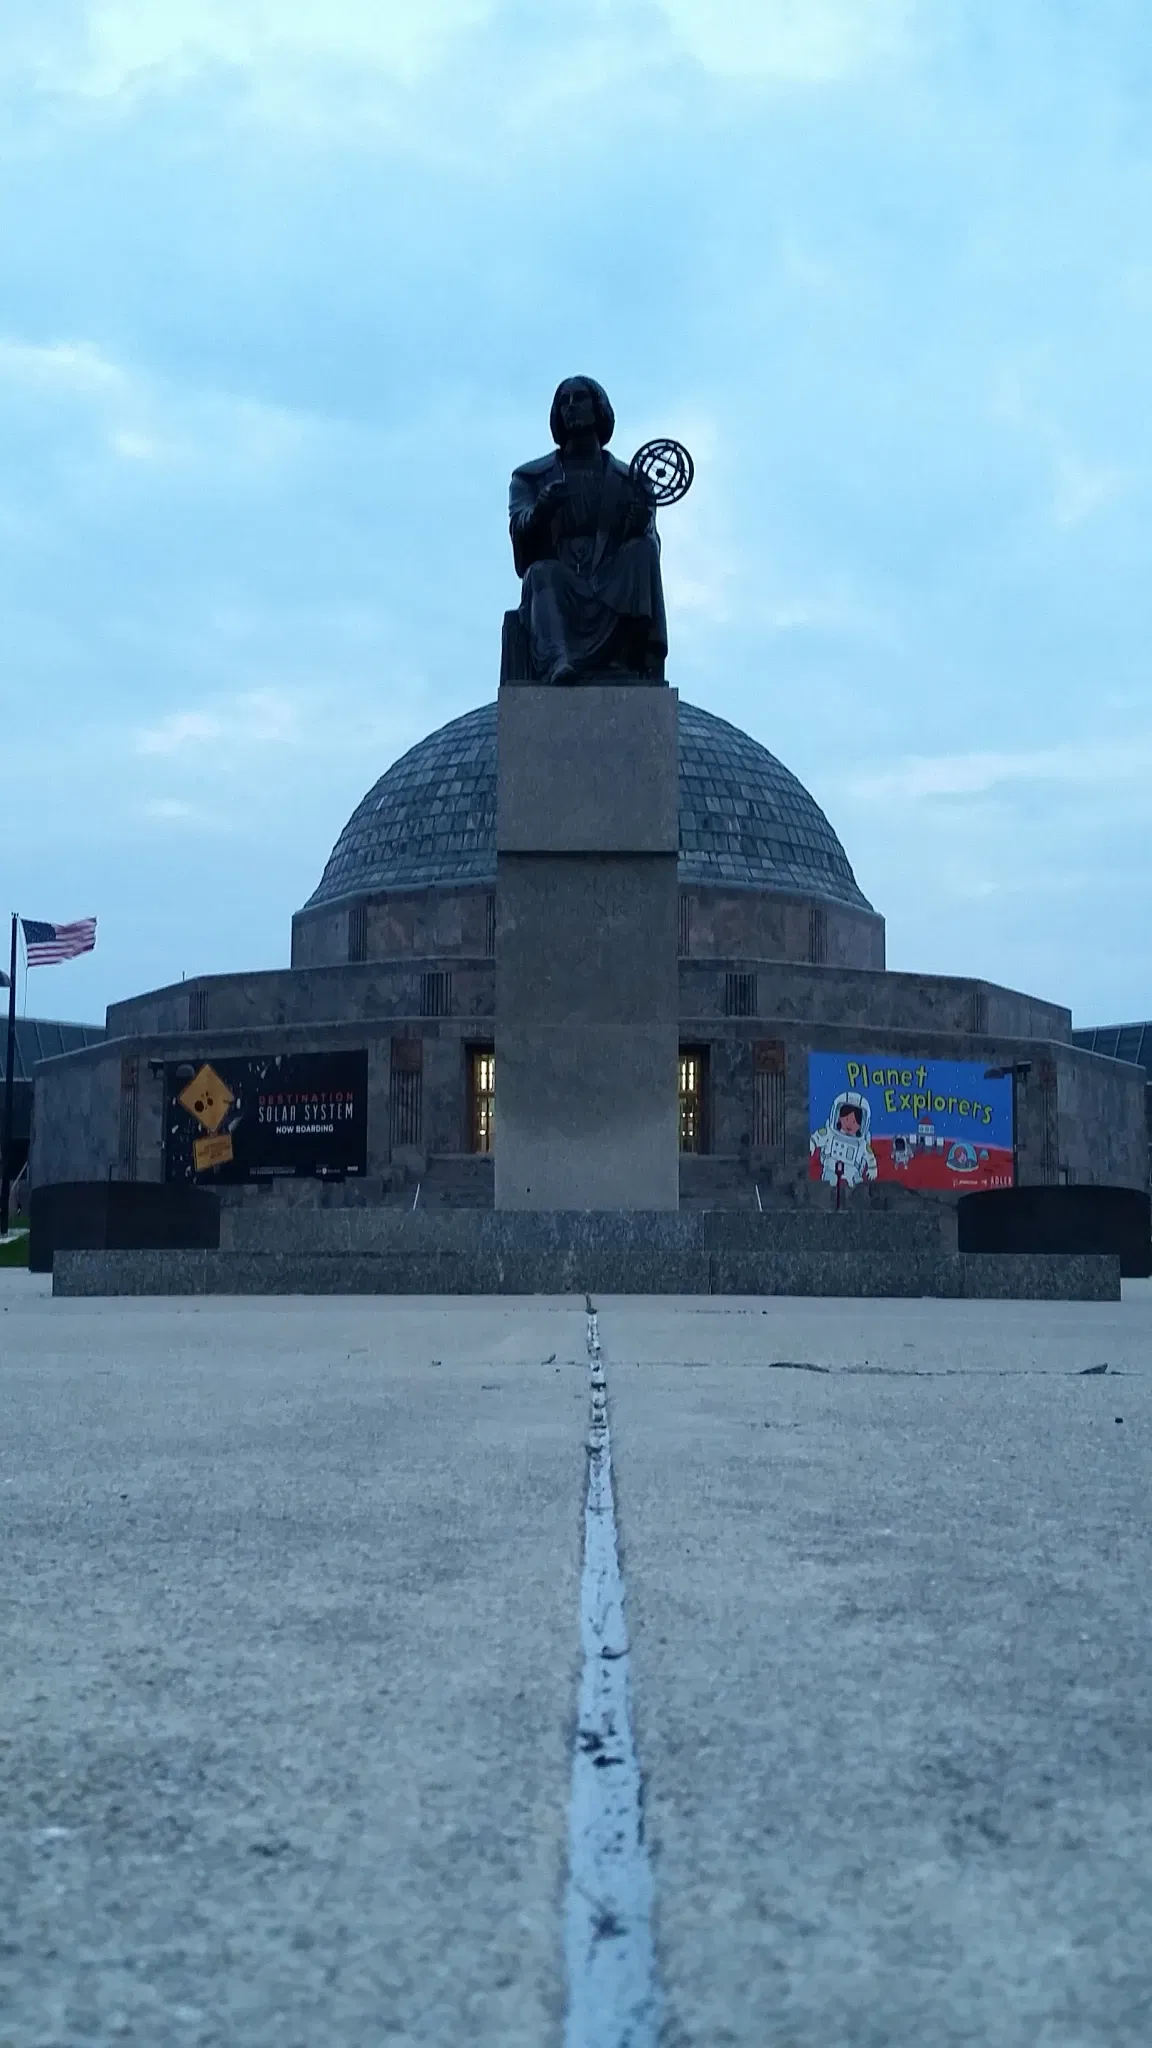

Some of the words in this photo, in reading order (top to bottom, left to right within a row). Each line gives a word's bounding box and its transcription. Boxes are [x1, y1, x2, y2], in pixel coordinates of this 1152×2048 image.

[847, 1061, 927, 1087] Planet
[258, 1092, 353, 1105] DESTINATION
[884, 1089, 993, 1124] Explorers
[258, 1104, 296, 1123] SOLAR
[304, 1102, 354, 1122] SYSTEM
[276, 1125, 294, 1135] NOW
[295, 1124, 334, 1134] BOARDING
